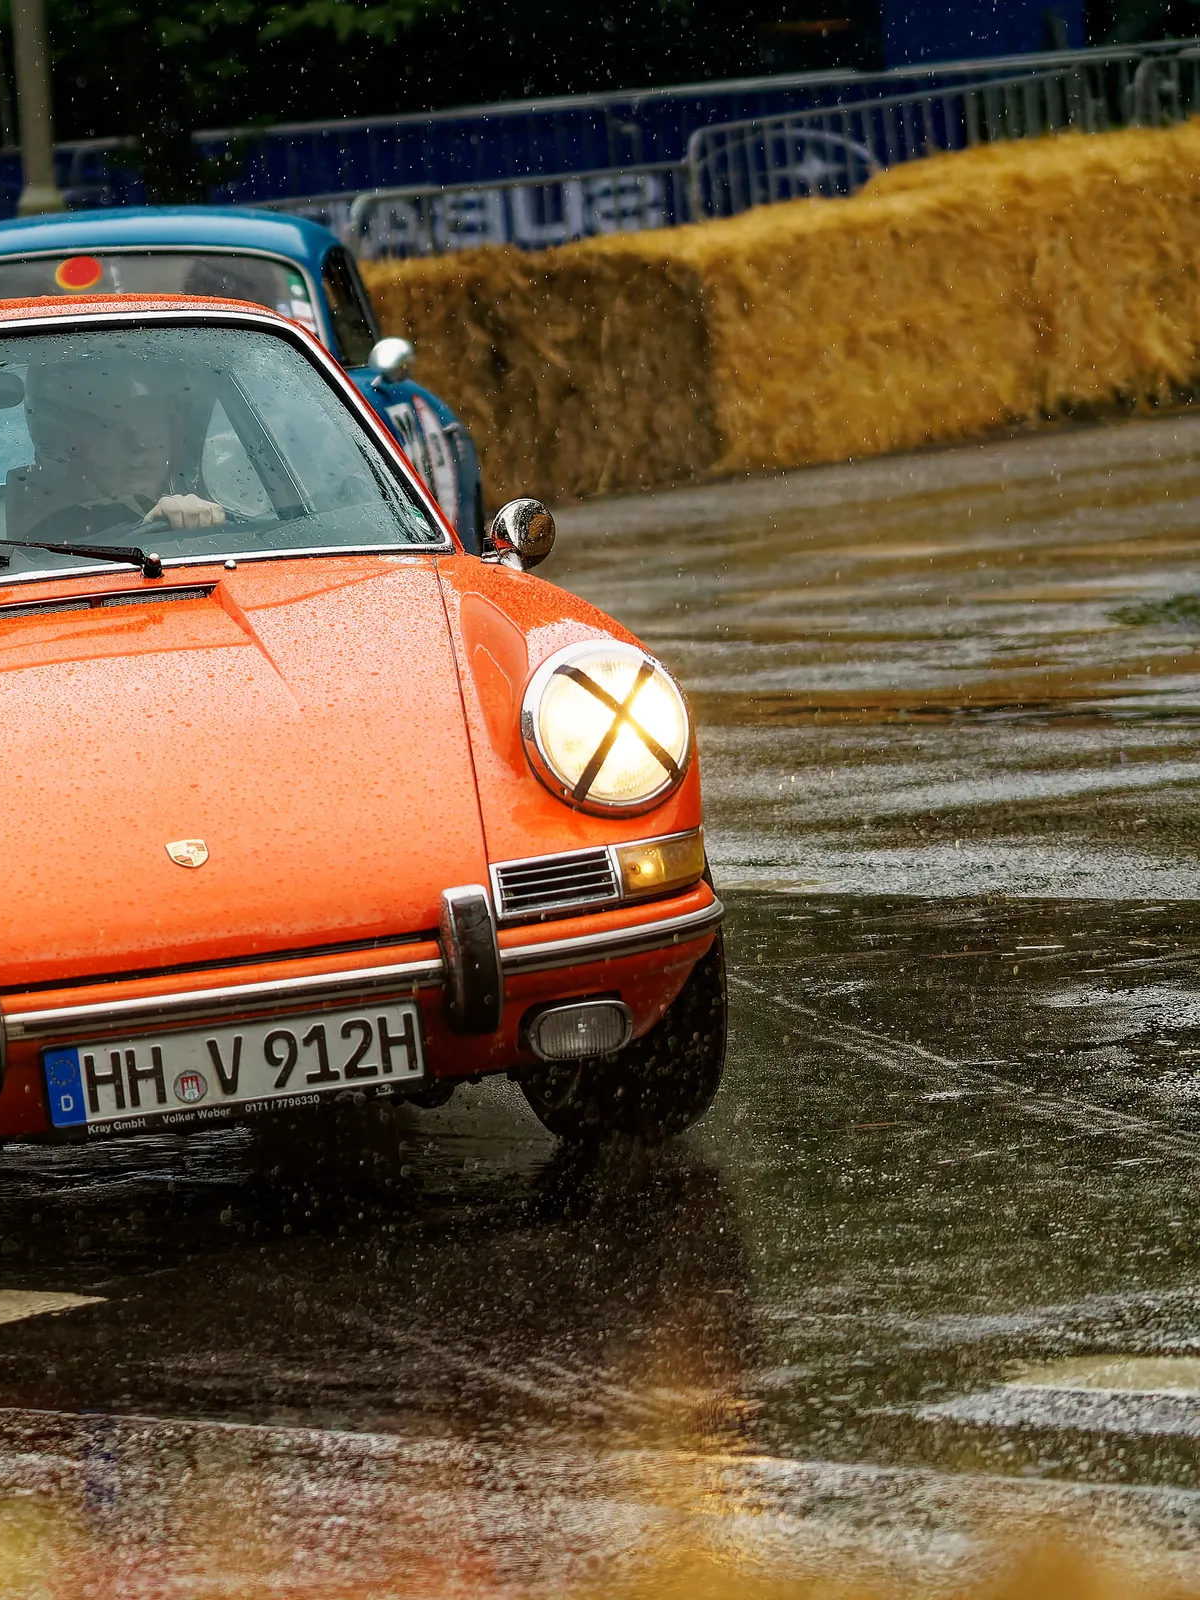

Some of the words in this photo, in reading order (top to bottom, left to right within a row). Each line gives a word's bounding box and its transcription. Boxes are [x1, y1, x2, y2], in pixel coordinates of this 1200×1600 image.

[83, 1046, 167, 1112] HH
[207, 1035, 242, 1095] V
[263, 1012, 418, 1088] 912H
[60, 1094, 74, 1111] D
[87, 1124, 111, 1135] Kray
[113, 1118, 147, 1130] GmbH
[162, 1113, 196, 1125] Volker
[197, 1108, 230, 1120] Weber
